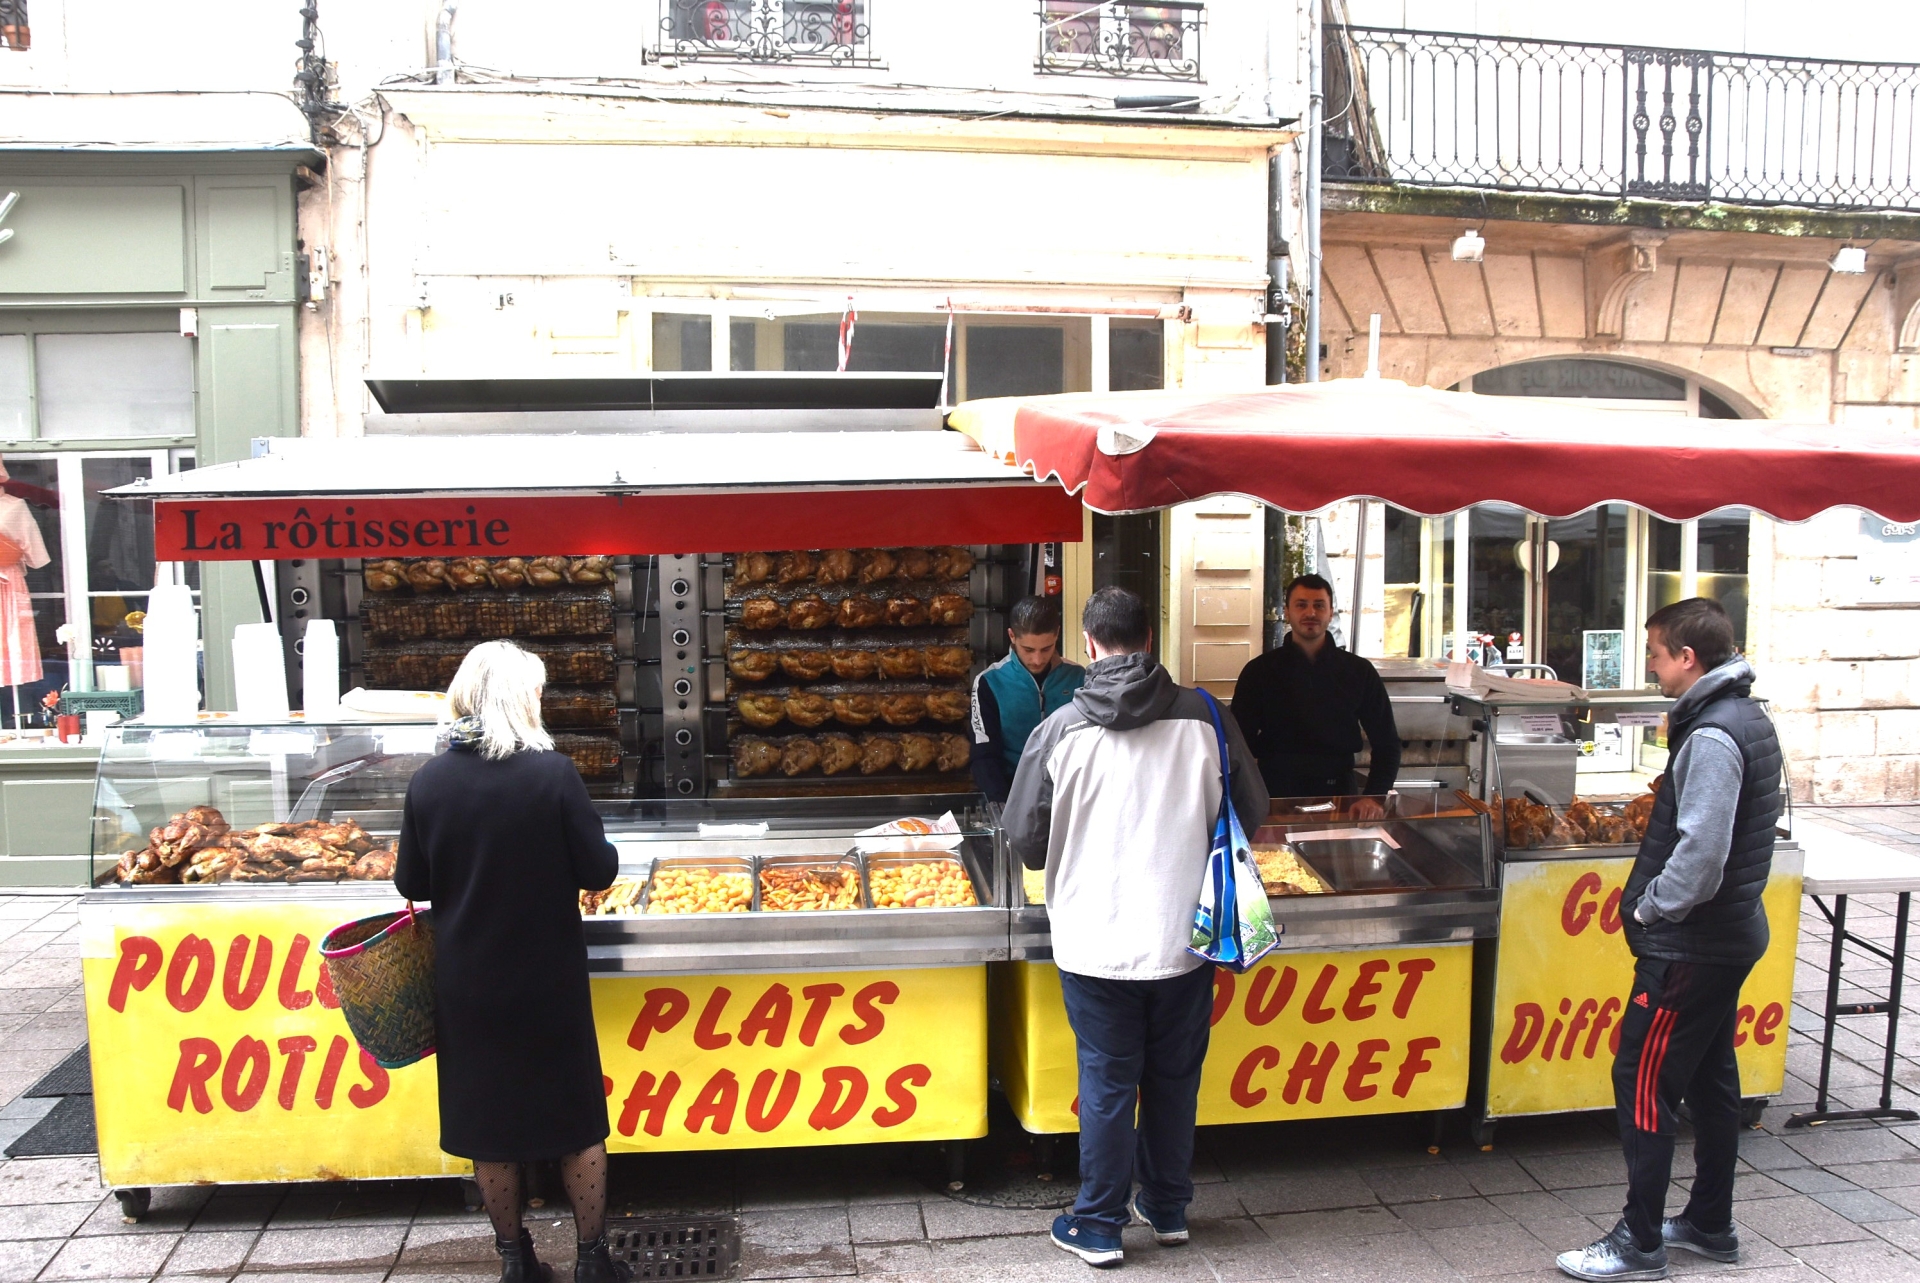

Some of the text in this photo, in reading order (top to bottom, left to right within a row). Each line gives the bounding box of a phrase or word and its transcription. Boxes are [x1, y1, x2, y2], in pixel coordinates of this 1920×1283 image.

[180, 506, 511, 551] La rôtisserie
[626, 980, 900, 1052] PLATS
[167, 1034, 390, 1114] ROTIS
[603, 1063, 932, 1138] HAUDS
[1229, 1036, 1441, 1109] CHEF
